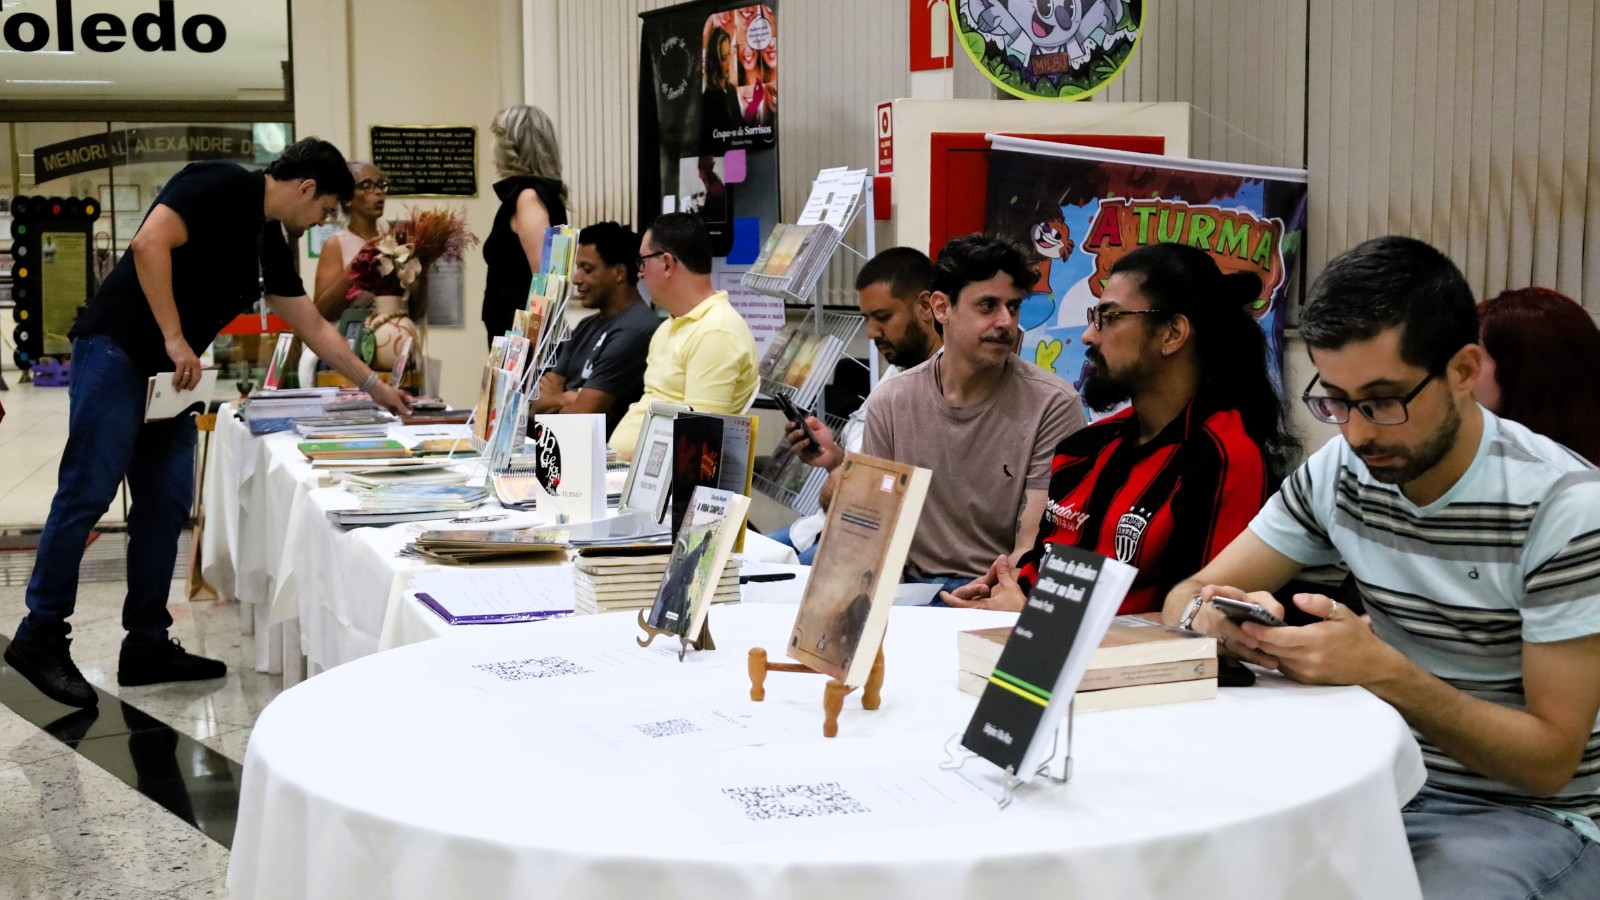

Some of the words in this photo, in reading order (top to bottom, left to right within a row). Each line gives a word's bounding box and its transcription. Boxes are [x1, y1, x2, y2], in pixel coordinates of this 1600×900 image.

[0, 0, 227, 53] oledo
[1035, 57, 1067, 72] MILBU
[744, 124, 772, 136] Sorrisos
[42, 140, 127, 172] MEMORIAL
[134, 135, 233, 154] ALEXANDRE
[1089, 206, 1122, 248] A
[1132, 205, 1273, 272] TURMA
[1065, 583, 1086, 602] Brasil
